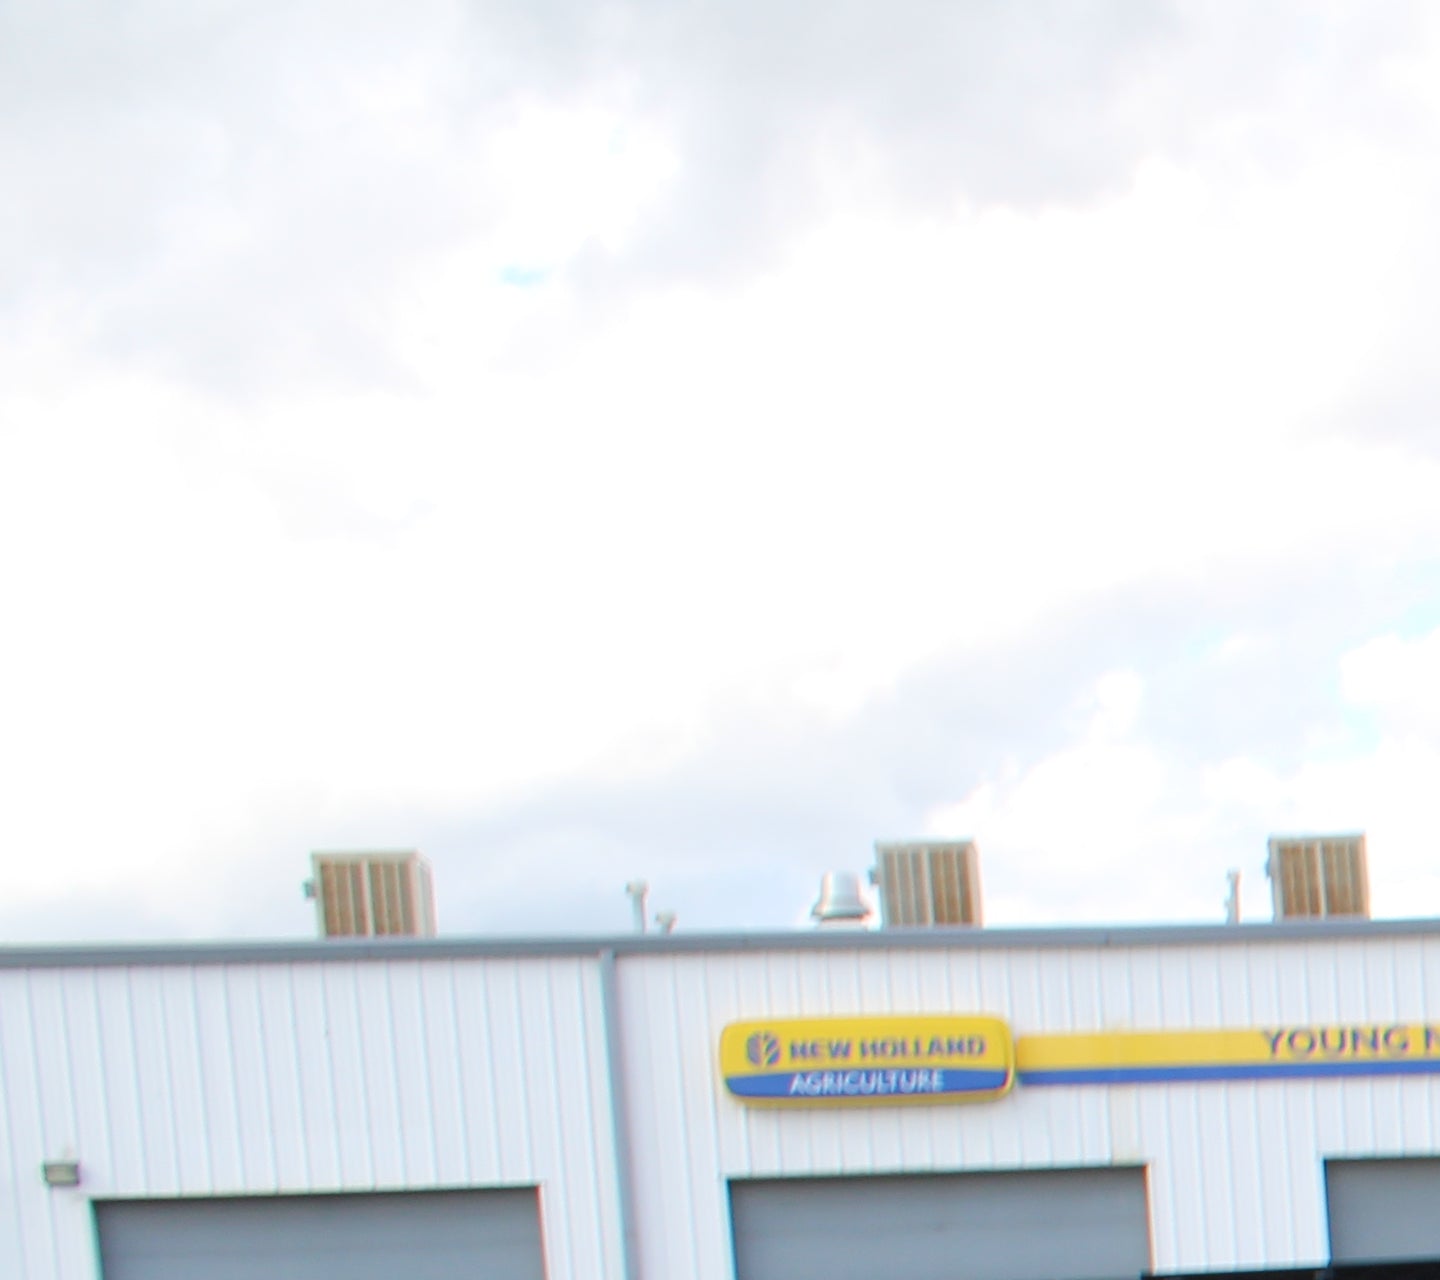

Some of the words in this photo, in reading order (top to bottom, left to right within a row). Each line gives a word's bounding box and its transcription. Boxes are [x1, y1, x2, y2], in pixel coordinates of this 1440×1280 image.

[789, 1038, 853, 1061] NEW
[858, 1033, 986, 1060] HOLLAND
[1262, 1024, 1408, 1059] YOUNG
[788, 1069, 945, 1096] AGRICULTURE
